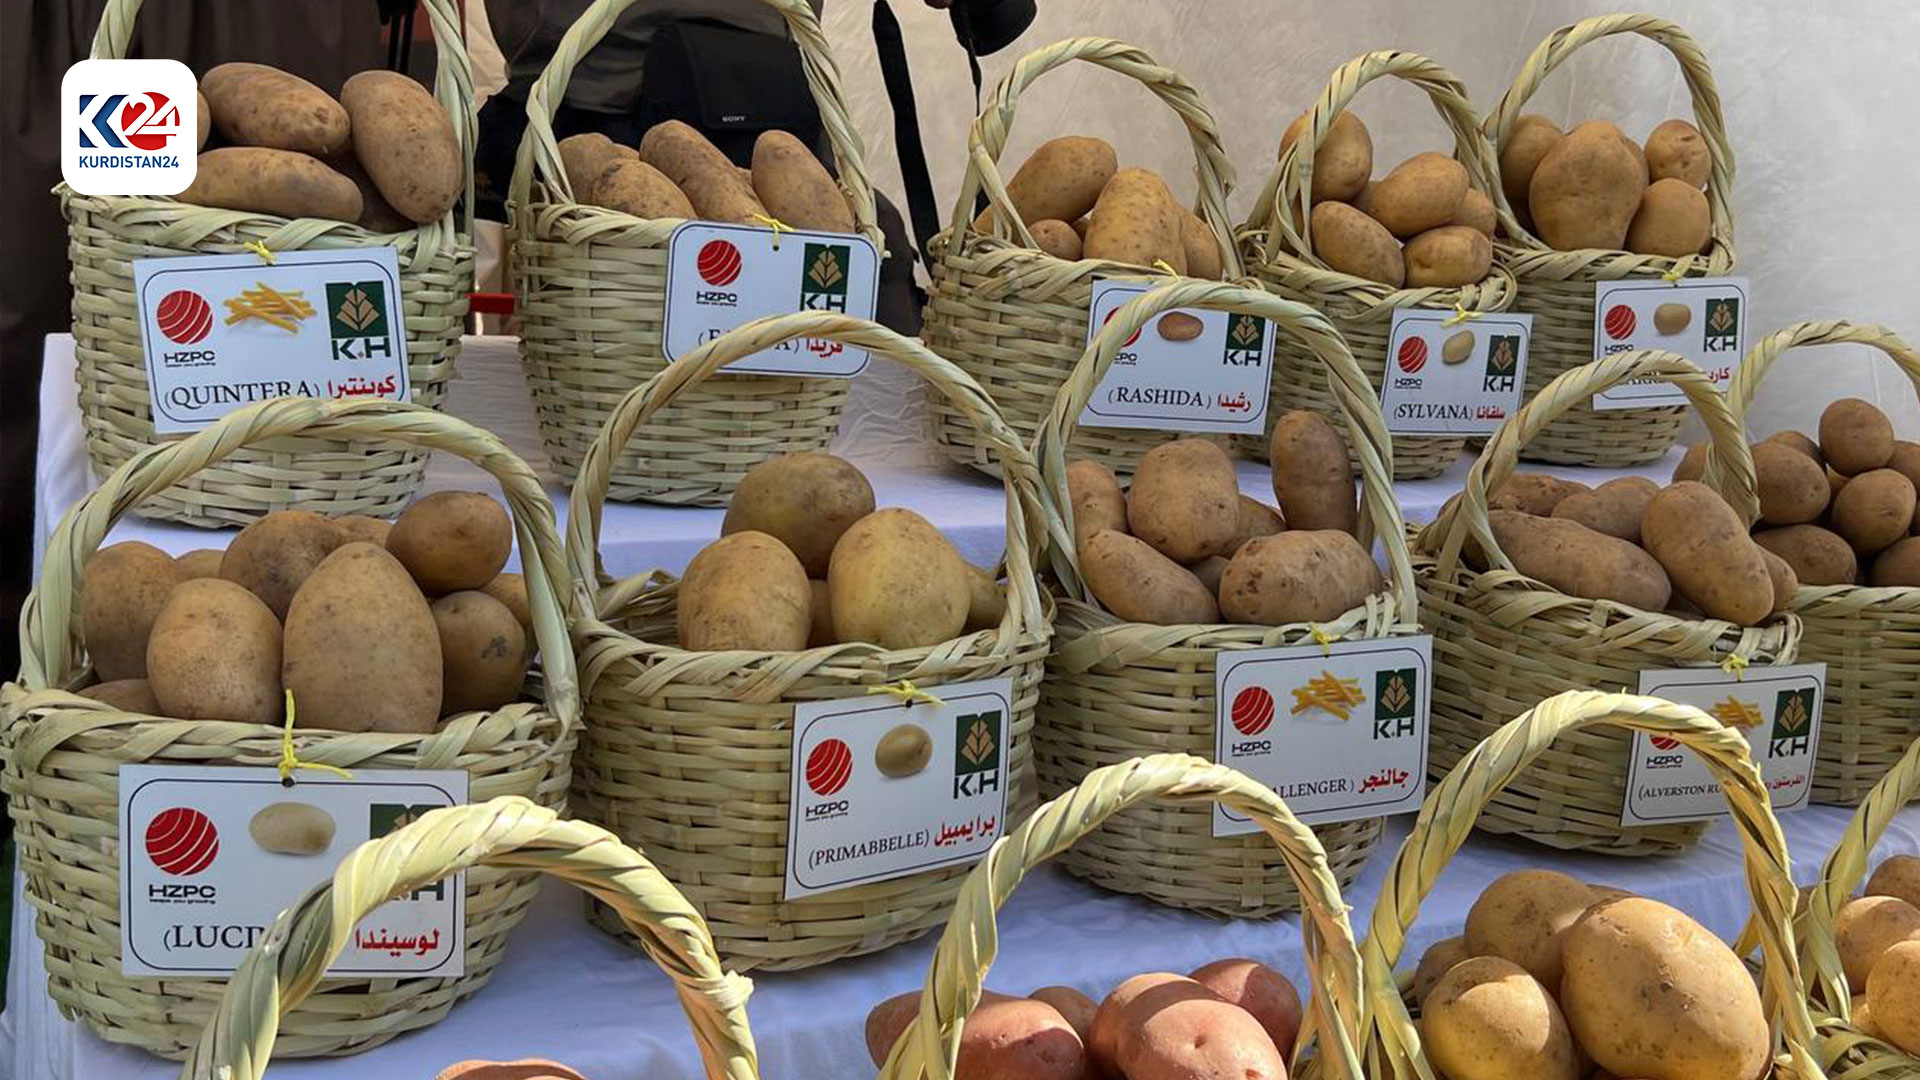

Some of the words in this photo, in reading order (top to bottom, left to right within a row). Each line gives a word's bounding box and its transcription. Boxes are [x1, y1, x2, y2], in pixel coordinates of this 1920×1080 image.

[697, 291, 737, 302] HZPC
[164, 350, 216, 363] HZPC
[1394, 403, 1473, 420] (SYLVANA)
[1231, 741, 1271, 753] HZPC
[1646, 755, 1683, 765] HZPC
[805, 800, 849, 817] HZPC
[808, 829, 930, 869] (PRIMABBELLE)
[149, 884, 216, 898] HZPC
[355, 927, 440, 957] لوسيندا
